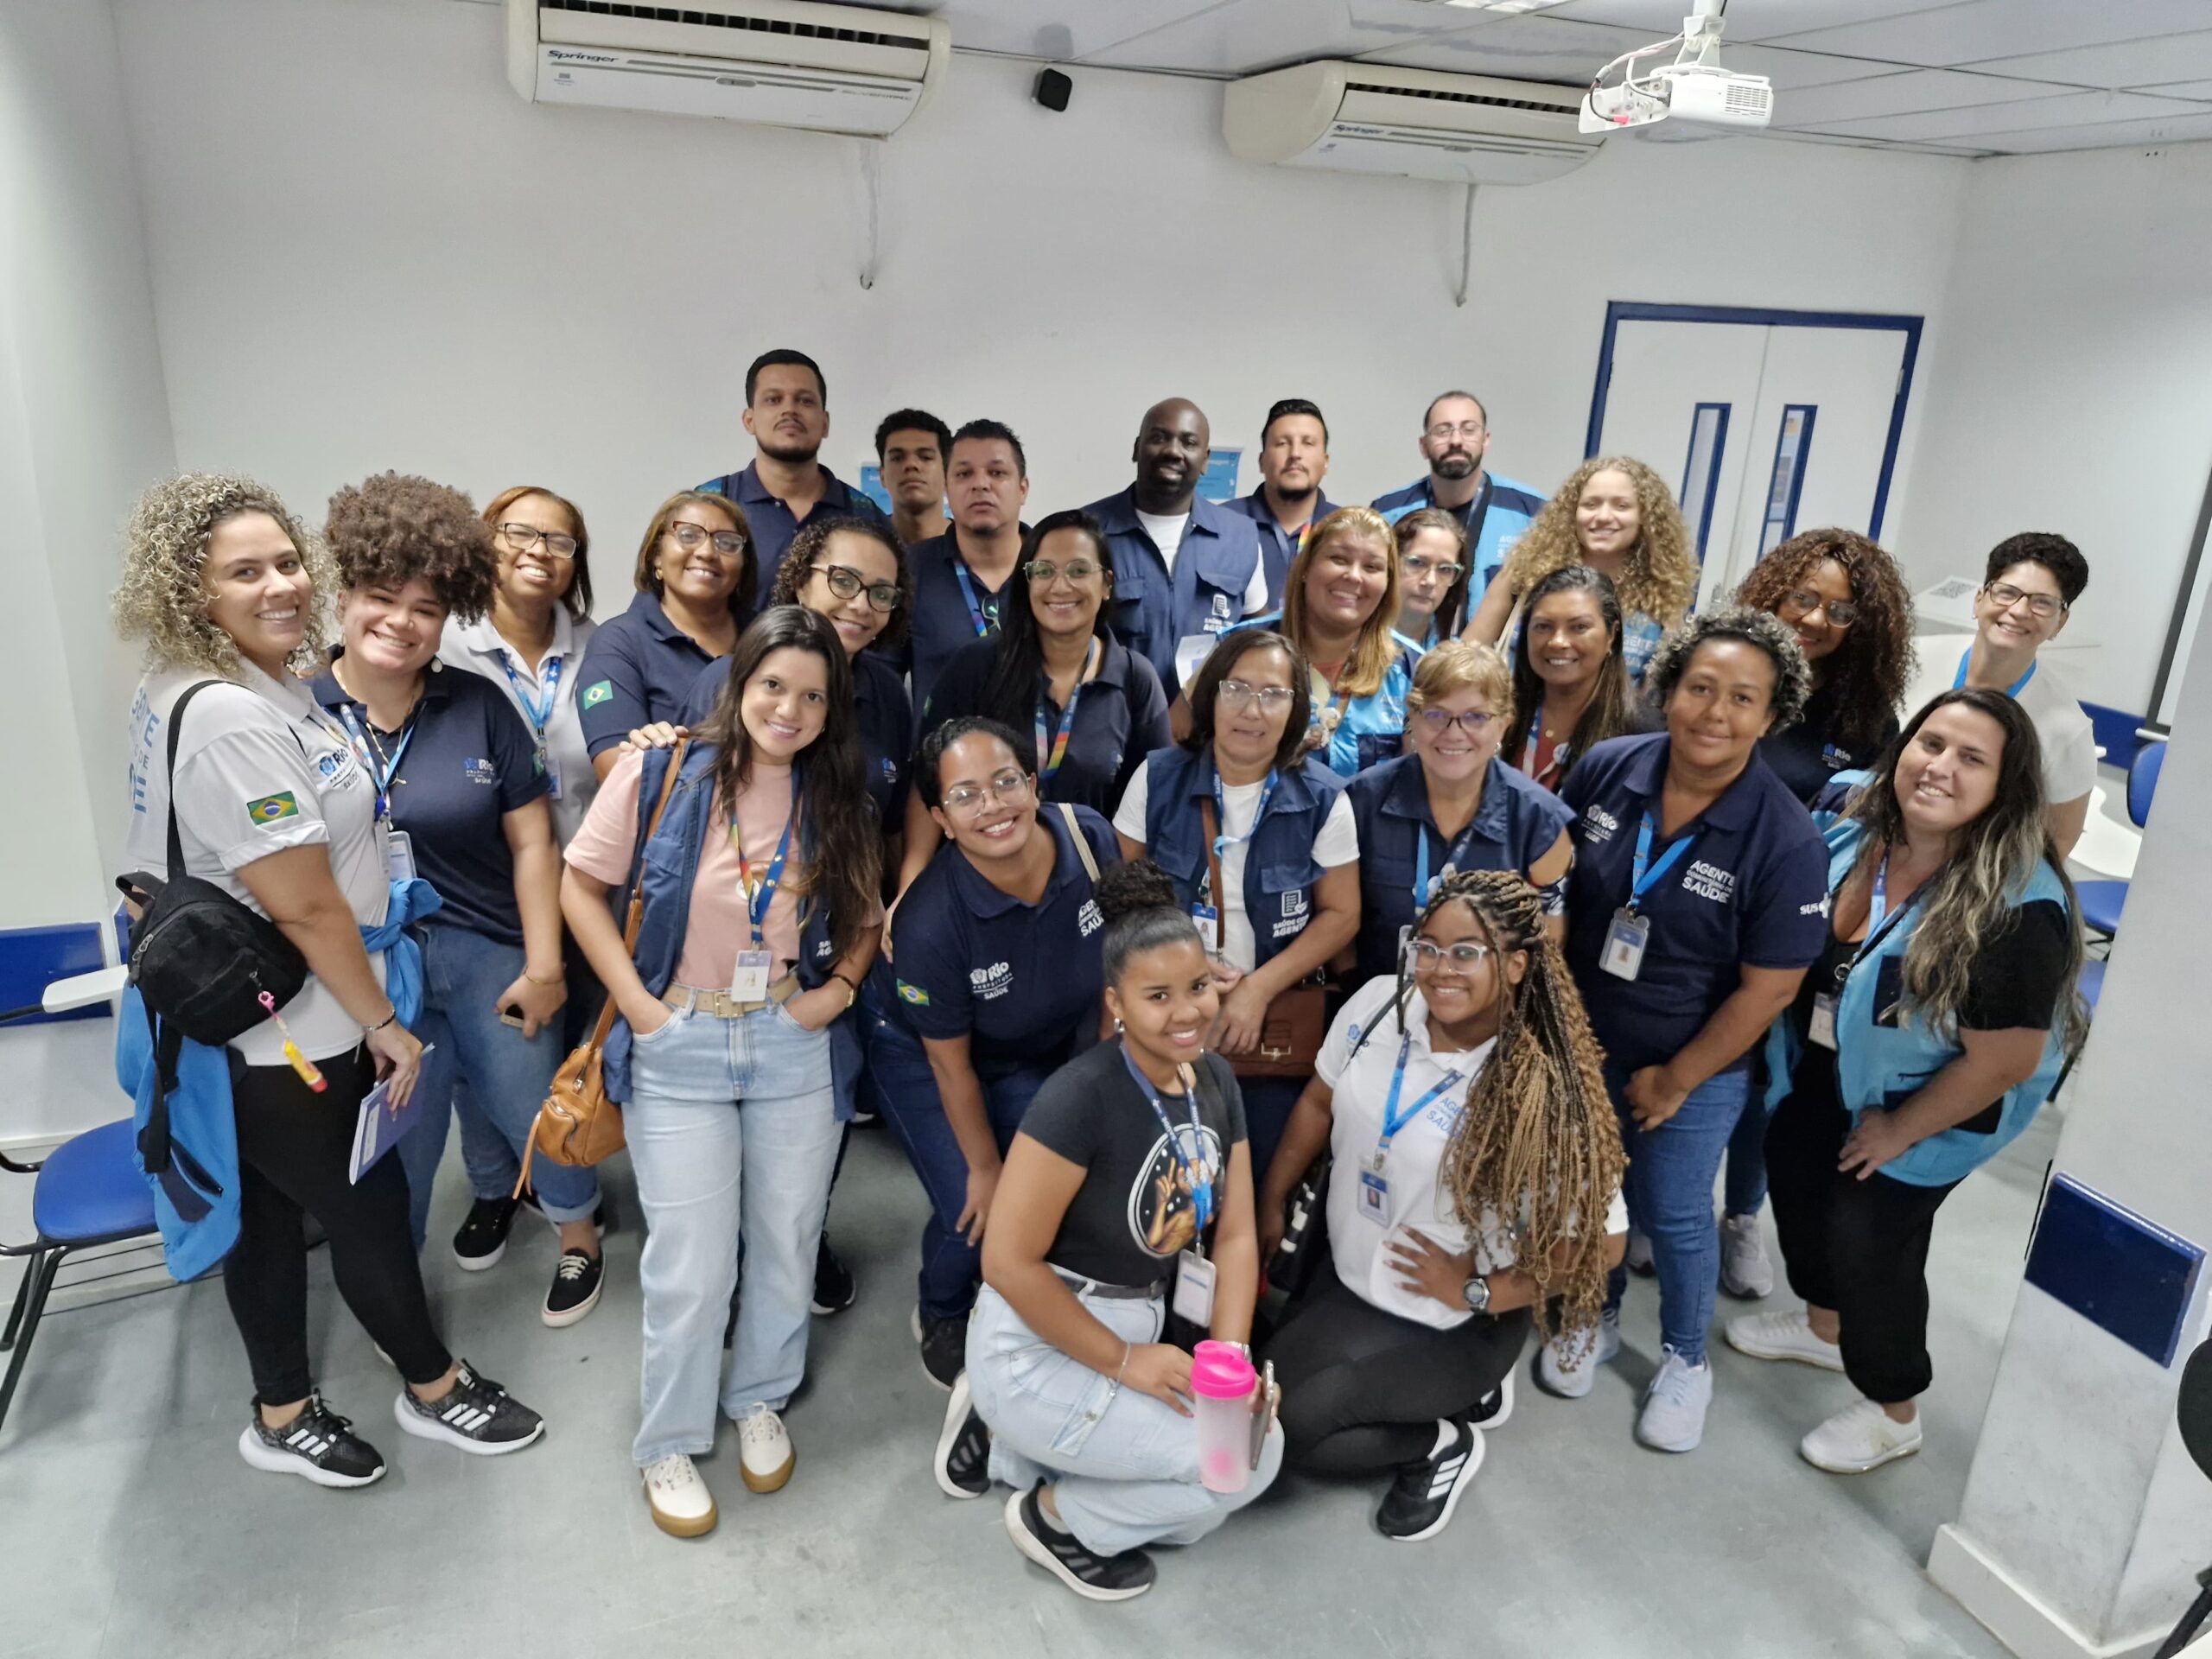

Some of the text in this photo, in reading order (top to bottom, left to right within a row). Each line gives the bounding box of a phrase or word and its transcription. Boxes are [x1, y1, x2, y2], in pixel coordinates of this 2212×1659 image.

[547, 49, 620, 63] Springer
[332, 747, 349, 766] Rio
[1599, 812, 1618, 831] Rio
[1690, 860, 1735, 887] AGENTE
[1681, 876, 1730, 905] SAÚDE
[1799, 903, 1819, 915] SUS
[987, 962, 1009, 982] Rio
[983, 985, 1009, 1000] SAÚDE
